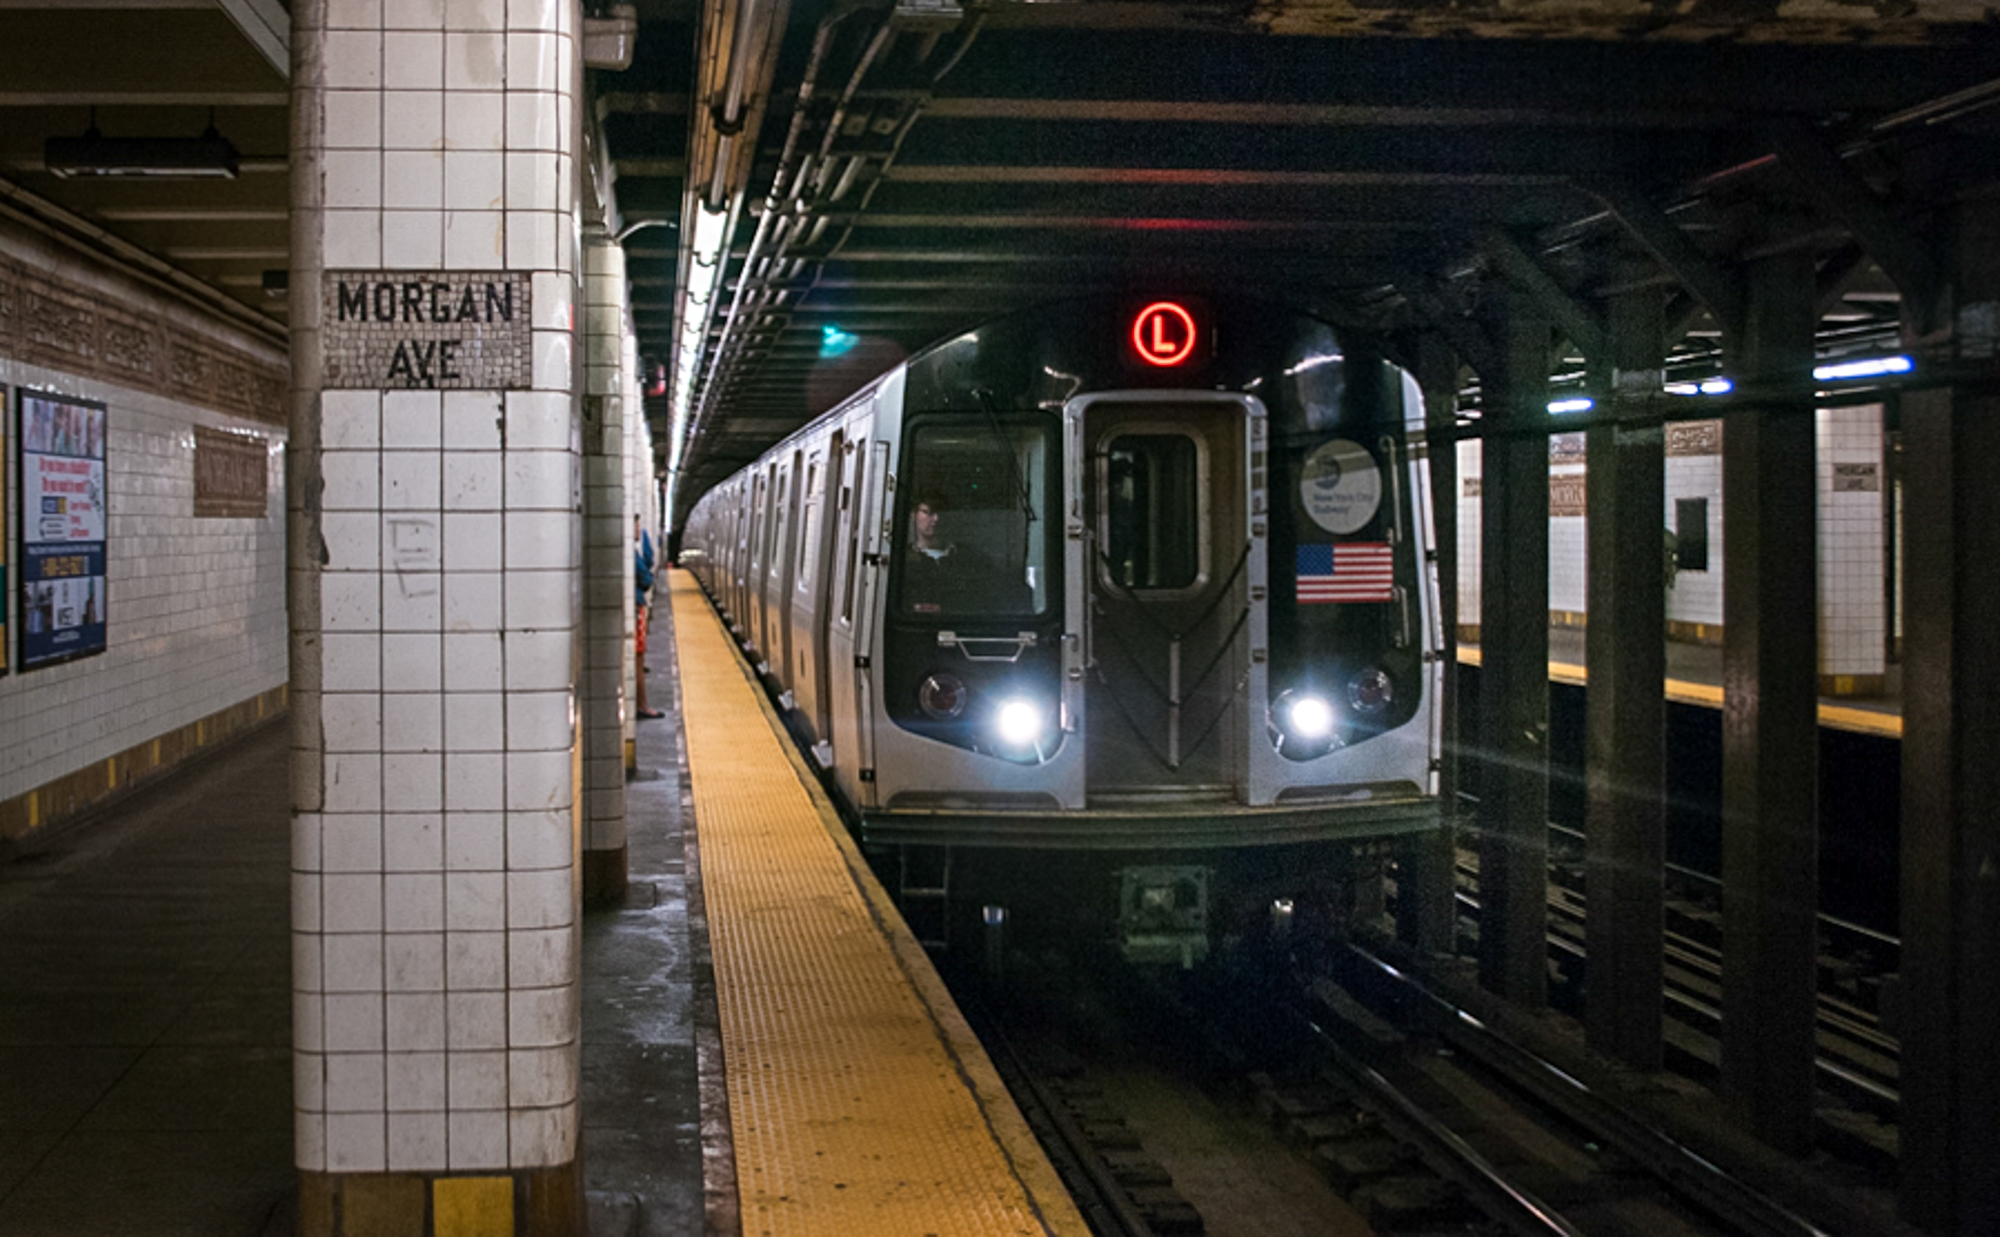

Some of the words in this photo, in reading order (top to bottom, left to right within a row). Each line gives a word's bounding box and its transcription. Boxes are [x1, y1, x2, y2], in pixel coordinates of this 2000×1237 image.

[338, 281, 512, 322] MORGAN
[1152, 314, 1176, 353] L
[387, 340, 460, 379] AVE
